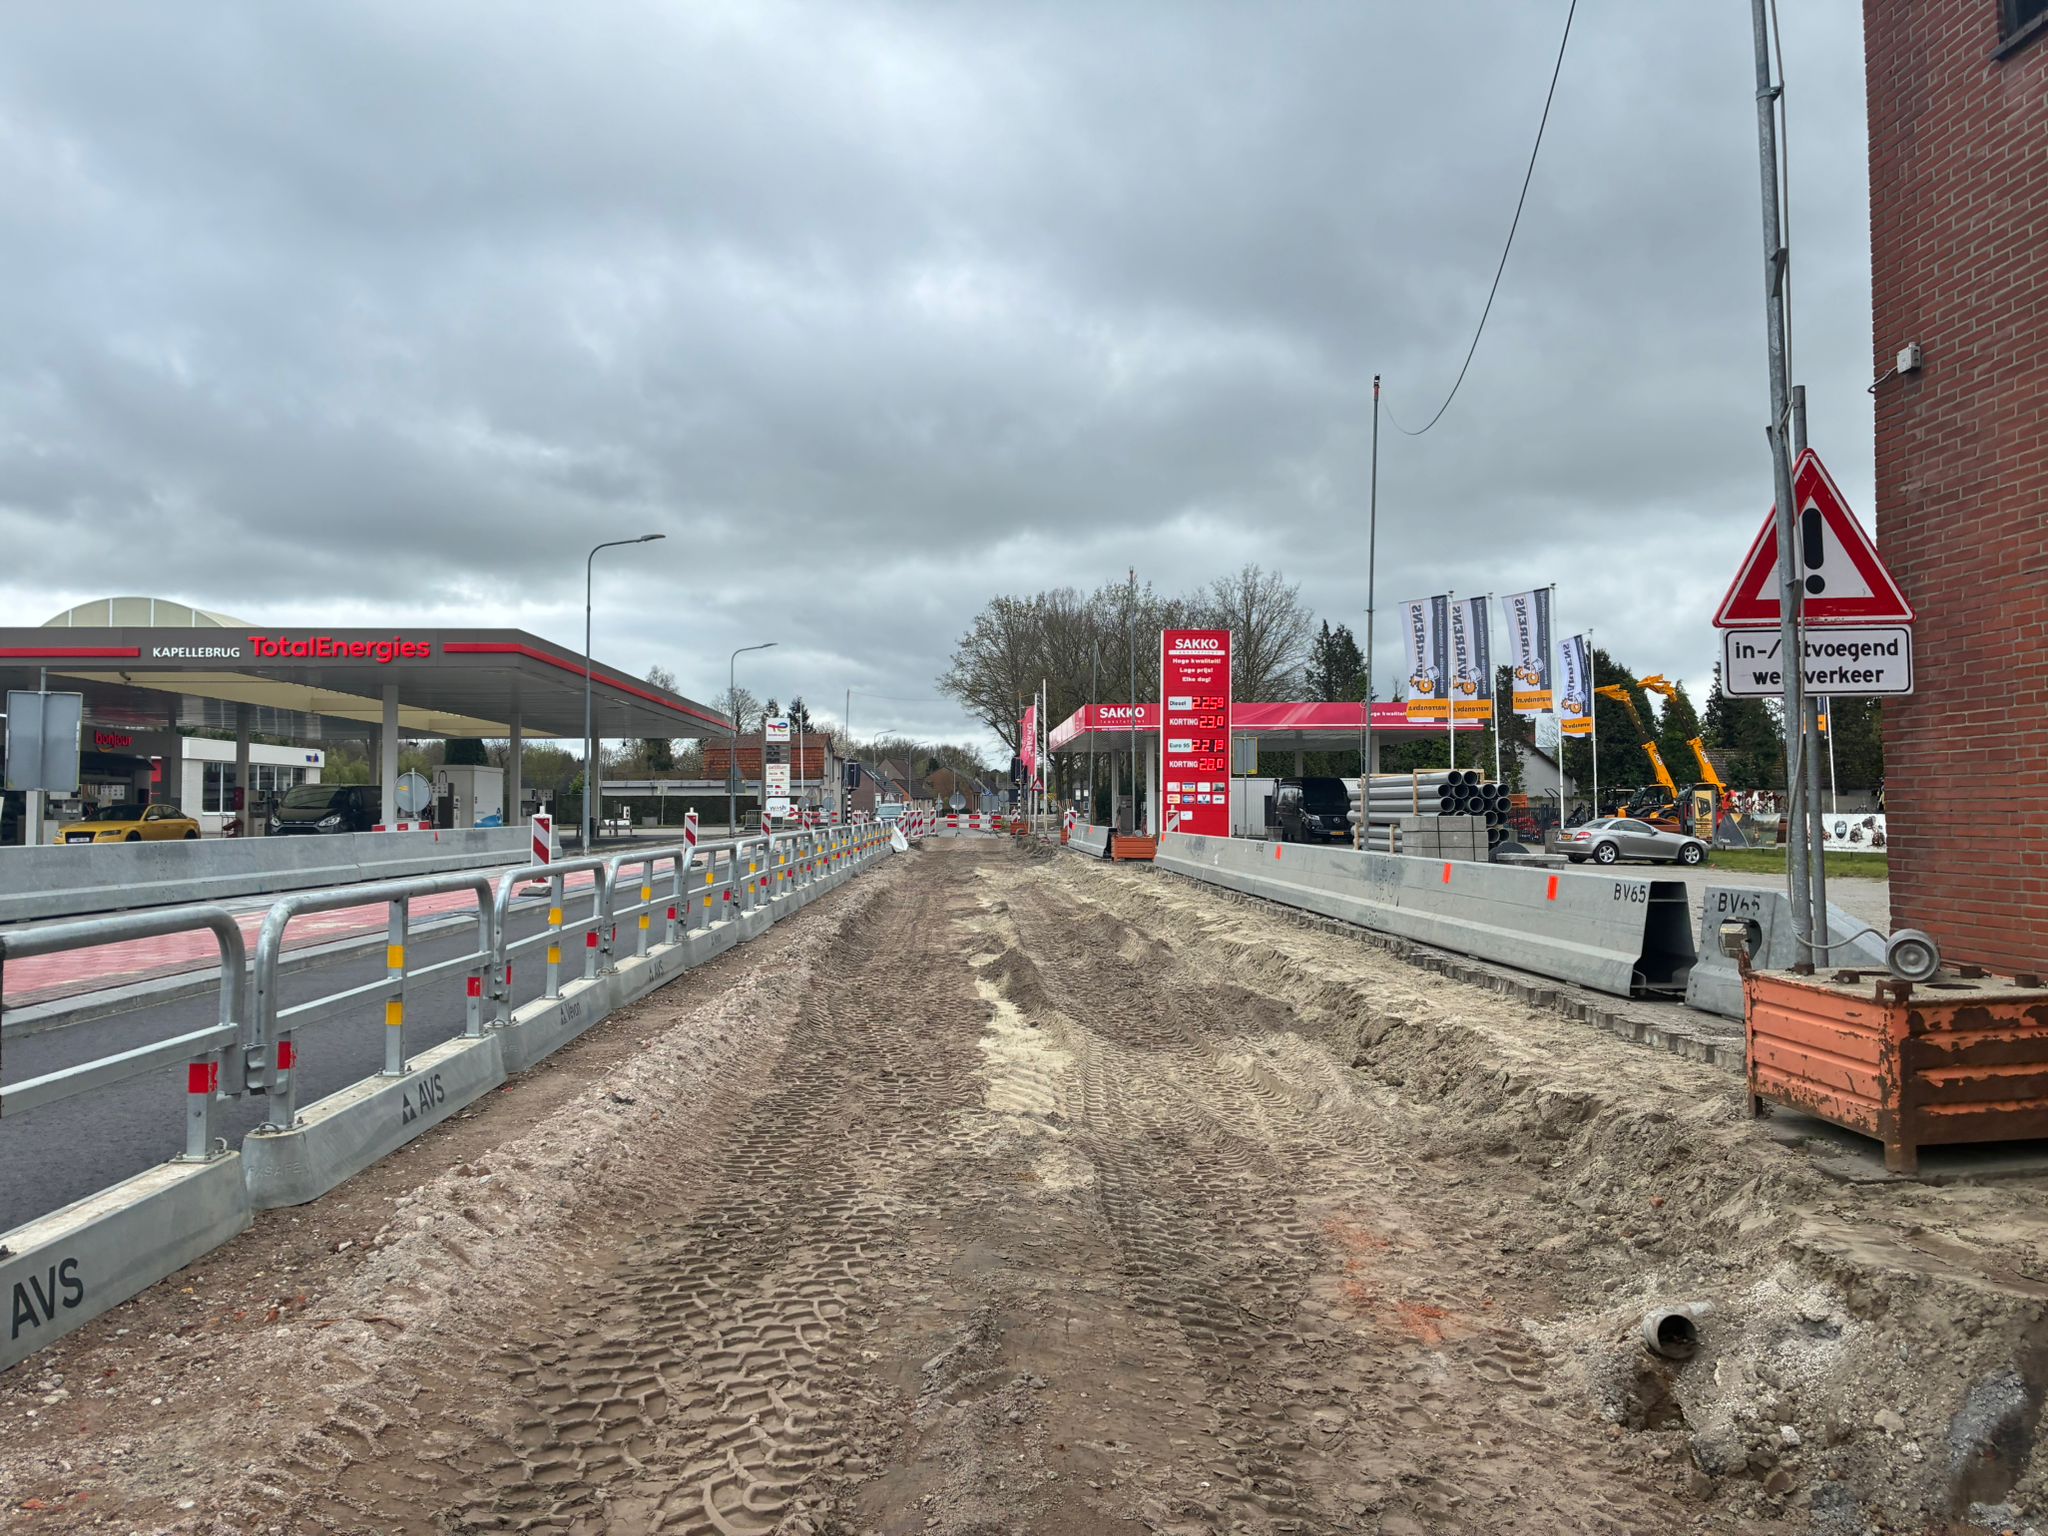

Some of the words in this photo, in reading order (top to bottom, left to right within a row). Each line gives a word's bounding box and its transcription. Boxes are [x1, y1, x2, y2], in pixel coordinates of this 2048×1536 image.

[152, 646, 241, 658] KAPELLEBRUG
[247, 636, 431, 664] TotalEnergies
[1175, 638, 1219, 650] SAKKO
[1099, 707, 1145, 718] SAKKO
[1169, 718, 1198, 726] KORTING
[1169, 761, 1198, 769] KORTING
[1614, 883, 1647, 904] BV65
[418, 1073, 445, 1115] AVS
[12, 1257, 84, 1340] AVS
